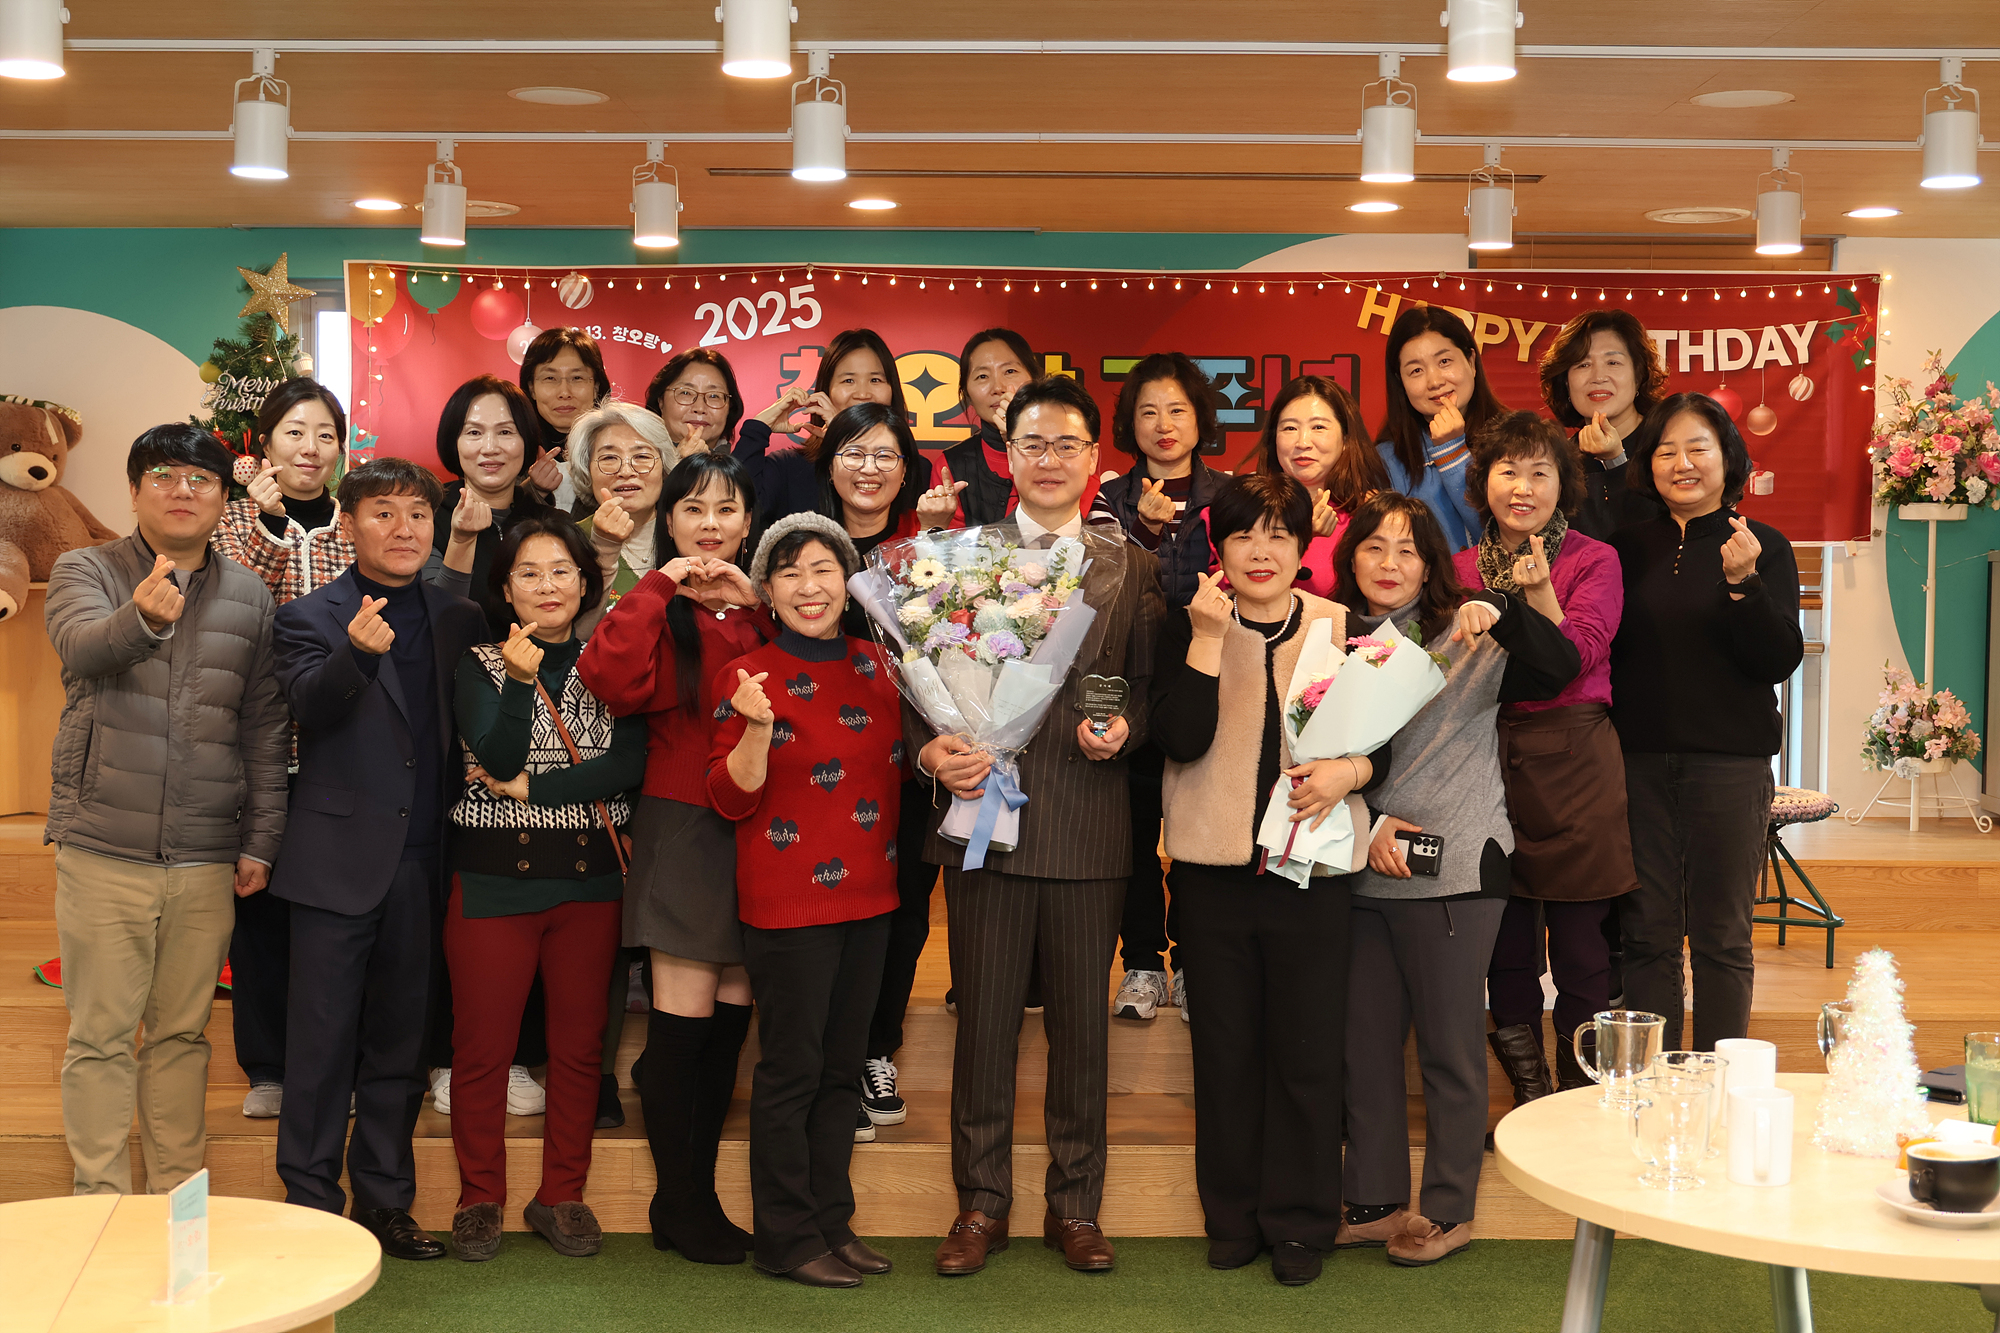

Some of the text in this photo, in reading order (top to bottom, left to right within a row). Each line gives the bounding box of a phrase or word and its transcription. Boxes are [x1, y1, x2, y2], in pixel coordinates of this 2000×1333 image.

[612, 325, 661, 350] 창오랑
[694, 284, 822, 348] 2025
[1357, 287, 1548, 363] HPY
